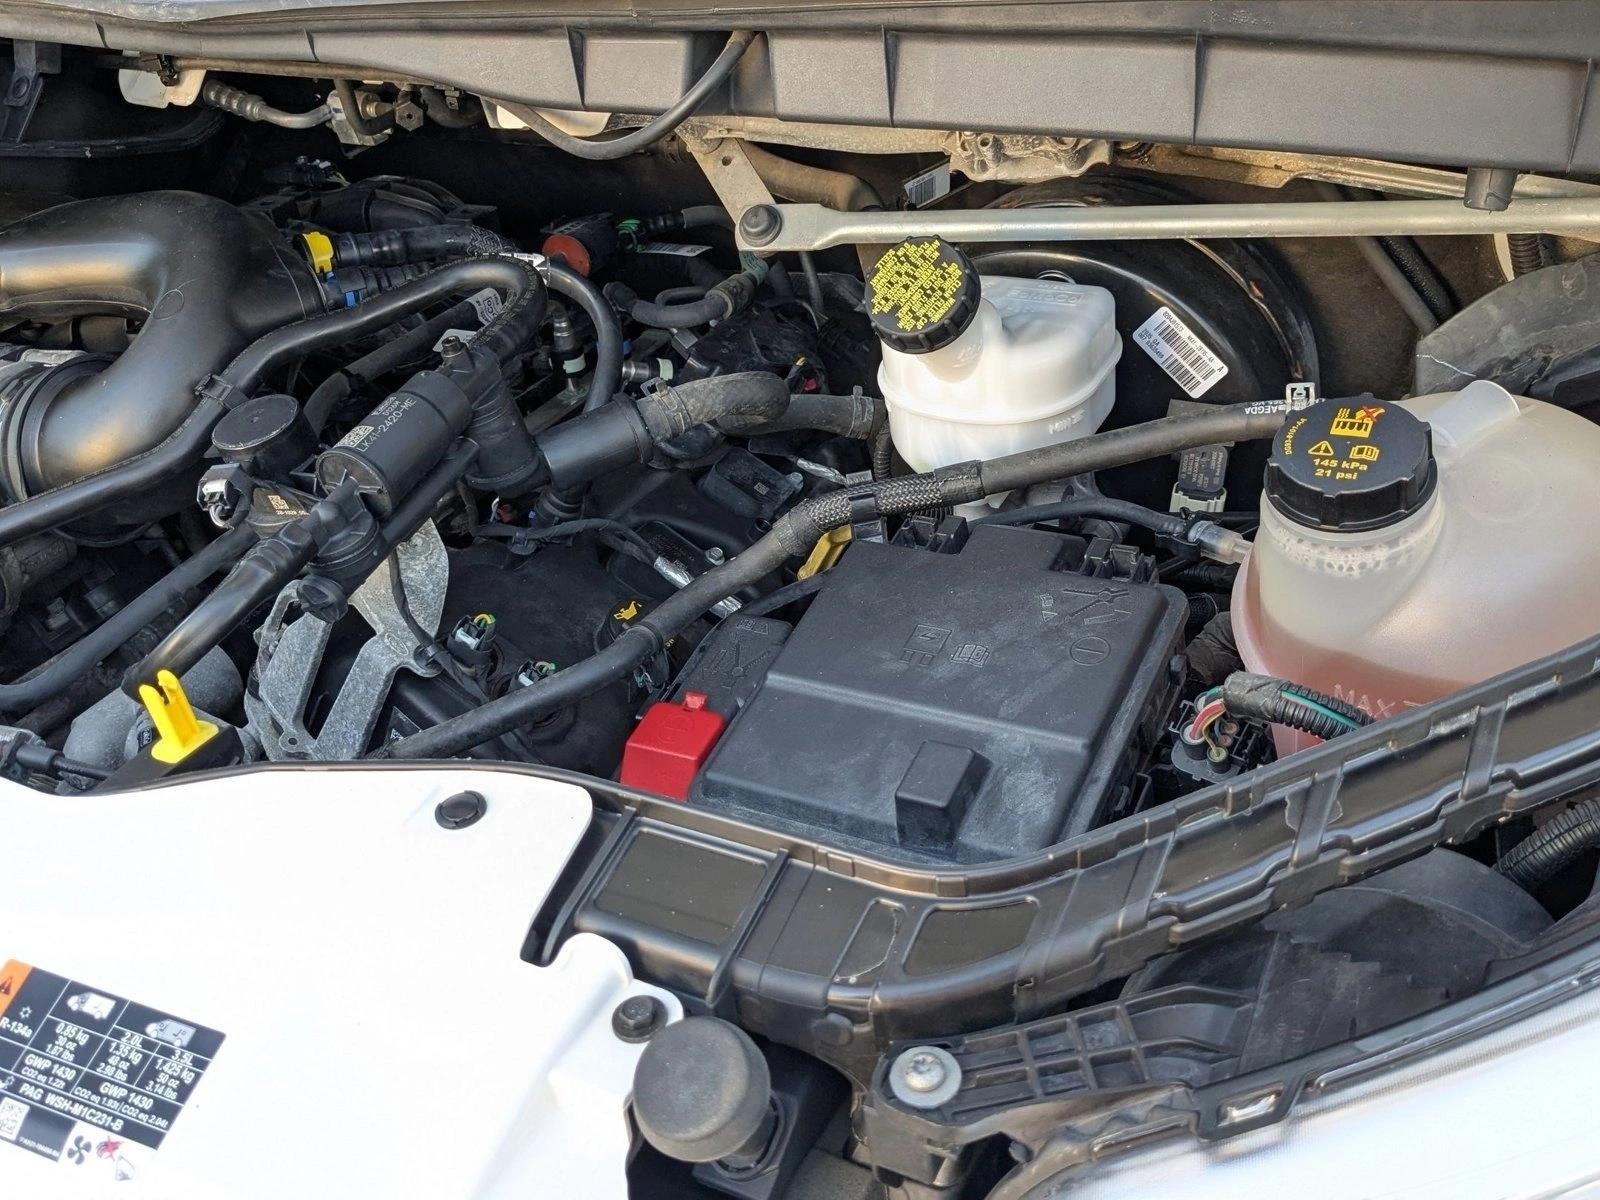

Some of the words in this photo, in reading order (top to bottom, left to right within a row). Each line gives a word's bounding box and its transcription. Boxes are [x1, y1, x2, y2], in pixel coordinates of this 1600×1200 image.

[905, 244, 917, 256] DOT
[909, 241, 929, 262] PLOYER
[923, 239, 940, 257] AVANT
[898, 262, 910, 274] QUE
[907, 266, 916, 274] LE
[913, 250, 939, 277] NETTOYER
[914, 257, 923, 266] DE
[943, 262, 957, 277] ONLY
[869, 256, 897, 286] CONTENANT
[873, 261, 901, 292] PROVENANT
[890, 274, 899, 283] DU
[922, 267, 942, 288] SEALED
[941, 268, 961, 290] BEFORE
[905, 277, 914, 286] LE
[931, 277, 943, 289] DOT
[943, 279, 961, 298] CLEAN
[871, 283, 891, 304] LIQUIDE
[881, 287, 906, 313] BOUCHON
[911, 295, 927, 311] FLUID
[926, 297, 944, 317] FILLER
[896, 311, 912, 328] FROM
[903, 318, 916, 331] USE
[915, 316, 927, 329] CAP
[1245, 405, 1278, 414] AEGDA
[1313, 459, 1338, 467] 145
[1341, 460, 1368, 471] kPa
[1315, 468, 1332, 477] 21
[1336, 472, 1358, 480] psi
[1333, 683, 1396, 718] MAX
[0, 1017, 33, 1038] R-134a
[55, 1022, 76, 1038] 0.85
[75, 1029, 89, 1045] kg
[55, 1035, 67, 1046] 30
[66, 1041, 77, 1051] oz
[121, 1031, 143, 1048] 2.0L
[46, 1044, 63, 1057] 1.87
[61, 1050, 75, 1062] lbs
[108, 1041, 129, 1058] 1.35
[128, 1049, 143, 1065] kg
[171, 1049, 193, 1066] 3.5L
[24, 1054, 52, 1070] GWP
[51, 1063, 76, 1080] 1430
[96, 1062, 116, 1076] 2.98
[114, 1069, 128, 1081] lbs
[108, 1055, 120, 1066] 48
[119, 1060, 130, 1070] oz
[155, 1058, 181, 1076] 1.425
[180, 1068, 195, 1084] kg
[21, 1066, 39, 1079] CO2
[37, 1072, 47, 1084] eq
[157, 1073, 169, 1084] 50
[167, 1078, 180, 1089] oz
[100, 1081, 128, 1098] GWP
[127, 1092, 154, 1110] 1430
[145, 1080, 164, 1095] 3.14
[164, 1088, 178, 1100] lbs
[19, 1083, 44, 1100] PAG
[45, 1092, 124, 1131] WSH-M1C231-B
[74, 1086, 91, 1099] CO2
[90, 1093, 101, 1104] eq
[121, 1104, 140, 1117] CO2
[138, 1112, 149, 1123] eq
[150, 1115, 169, 1128] 2.04t
